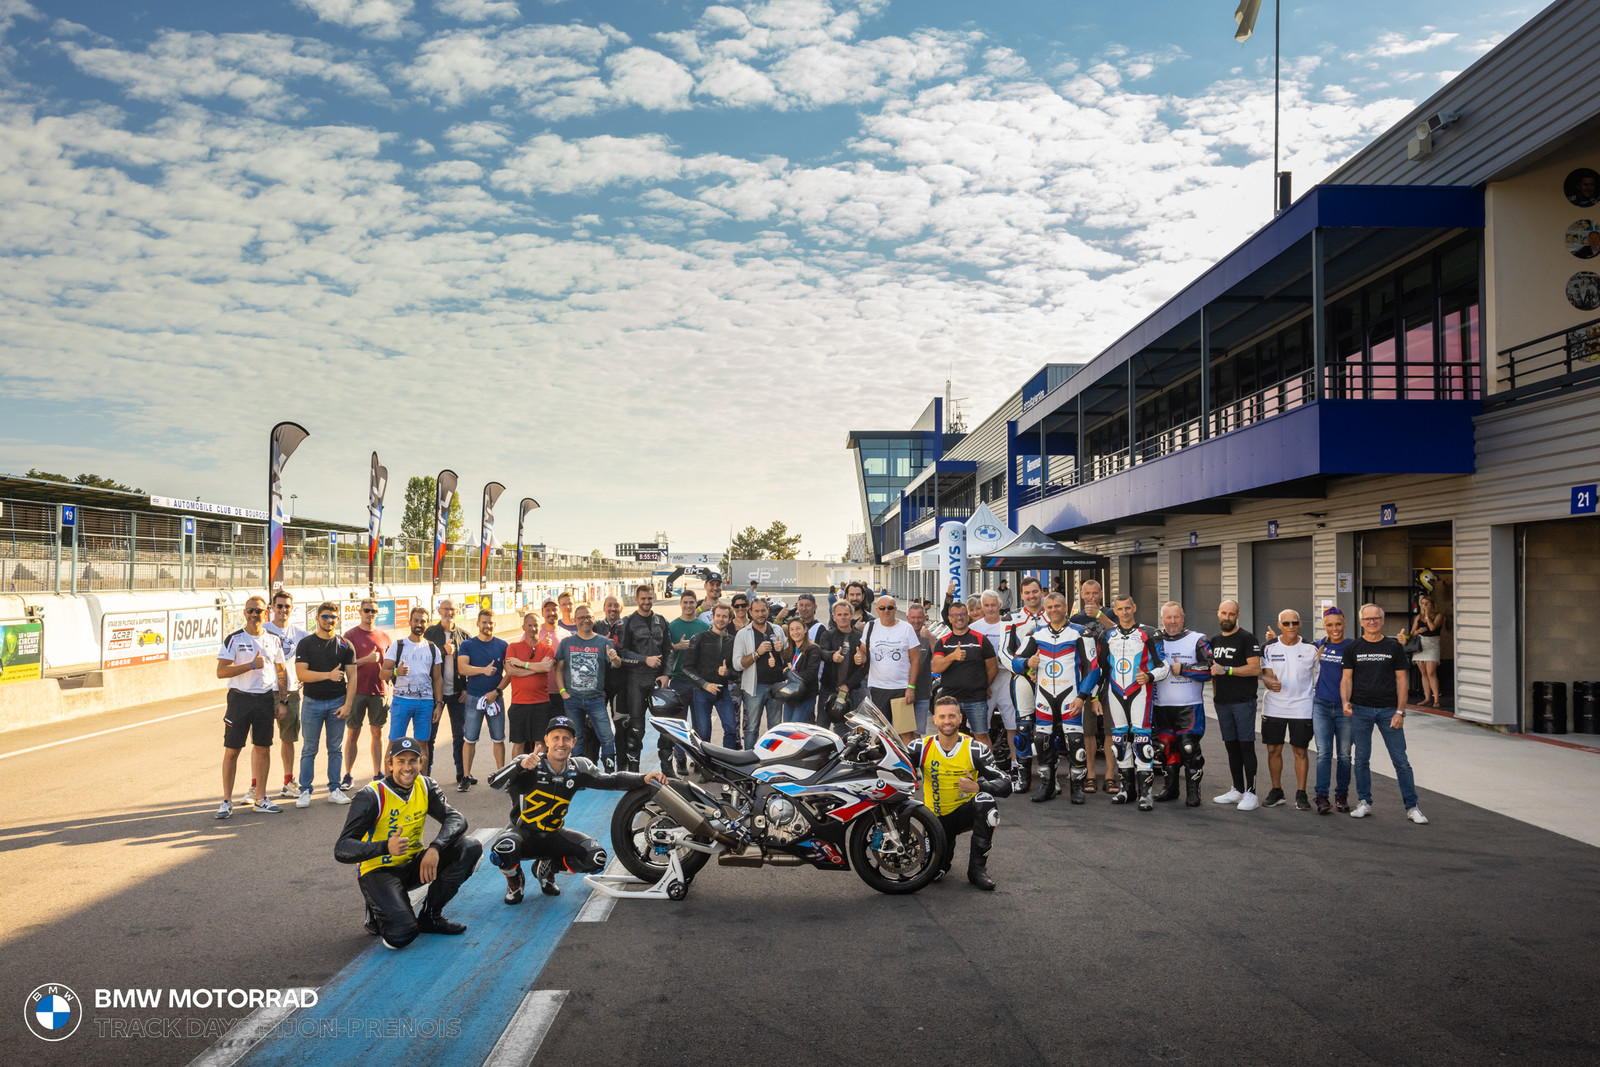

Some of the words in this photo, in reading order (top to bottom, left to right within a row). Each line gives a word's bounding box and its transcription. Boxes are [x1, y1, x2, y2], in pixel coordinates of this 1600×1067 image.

[1577, 492, 1589, 507] 21
[173, 499, 213, 512] AUTOMOBILE
[216, 505, 231, 515] CLUB
[235, 508, 242, 516] DE
[65, 510, 73, 520] 19
[1383, 508, 1392, 521] 20
[1019, 541, 1056, 550] BMC
[684, 567, 704, 575] BMC
[173, 617, 218, 642] ISOPLAC
[18, 637, 39, 645] CIRCUIT
[1213, 647, 1236, 659] BMC
